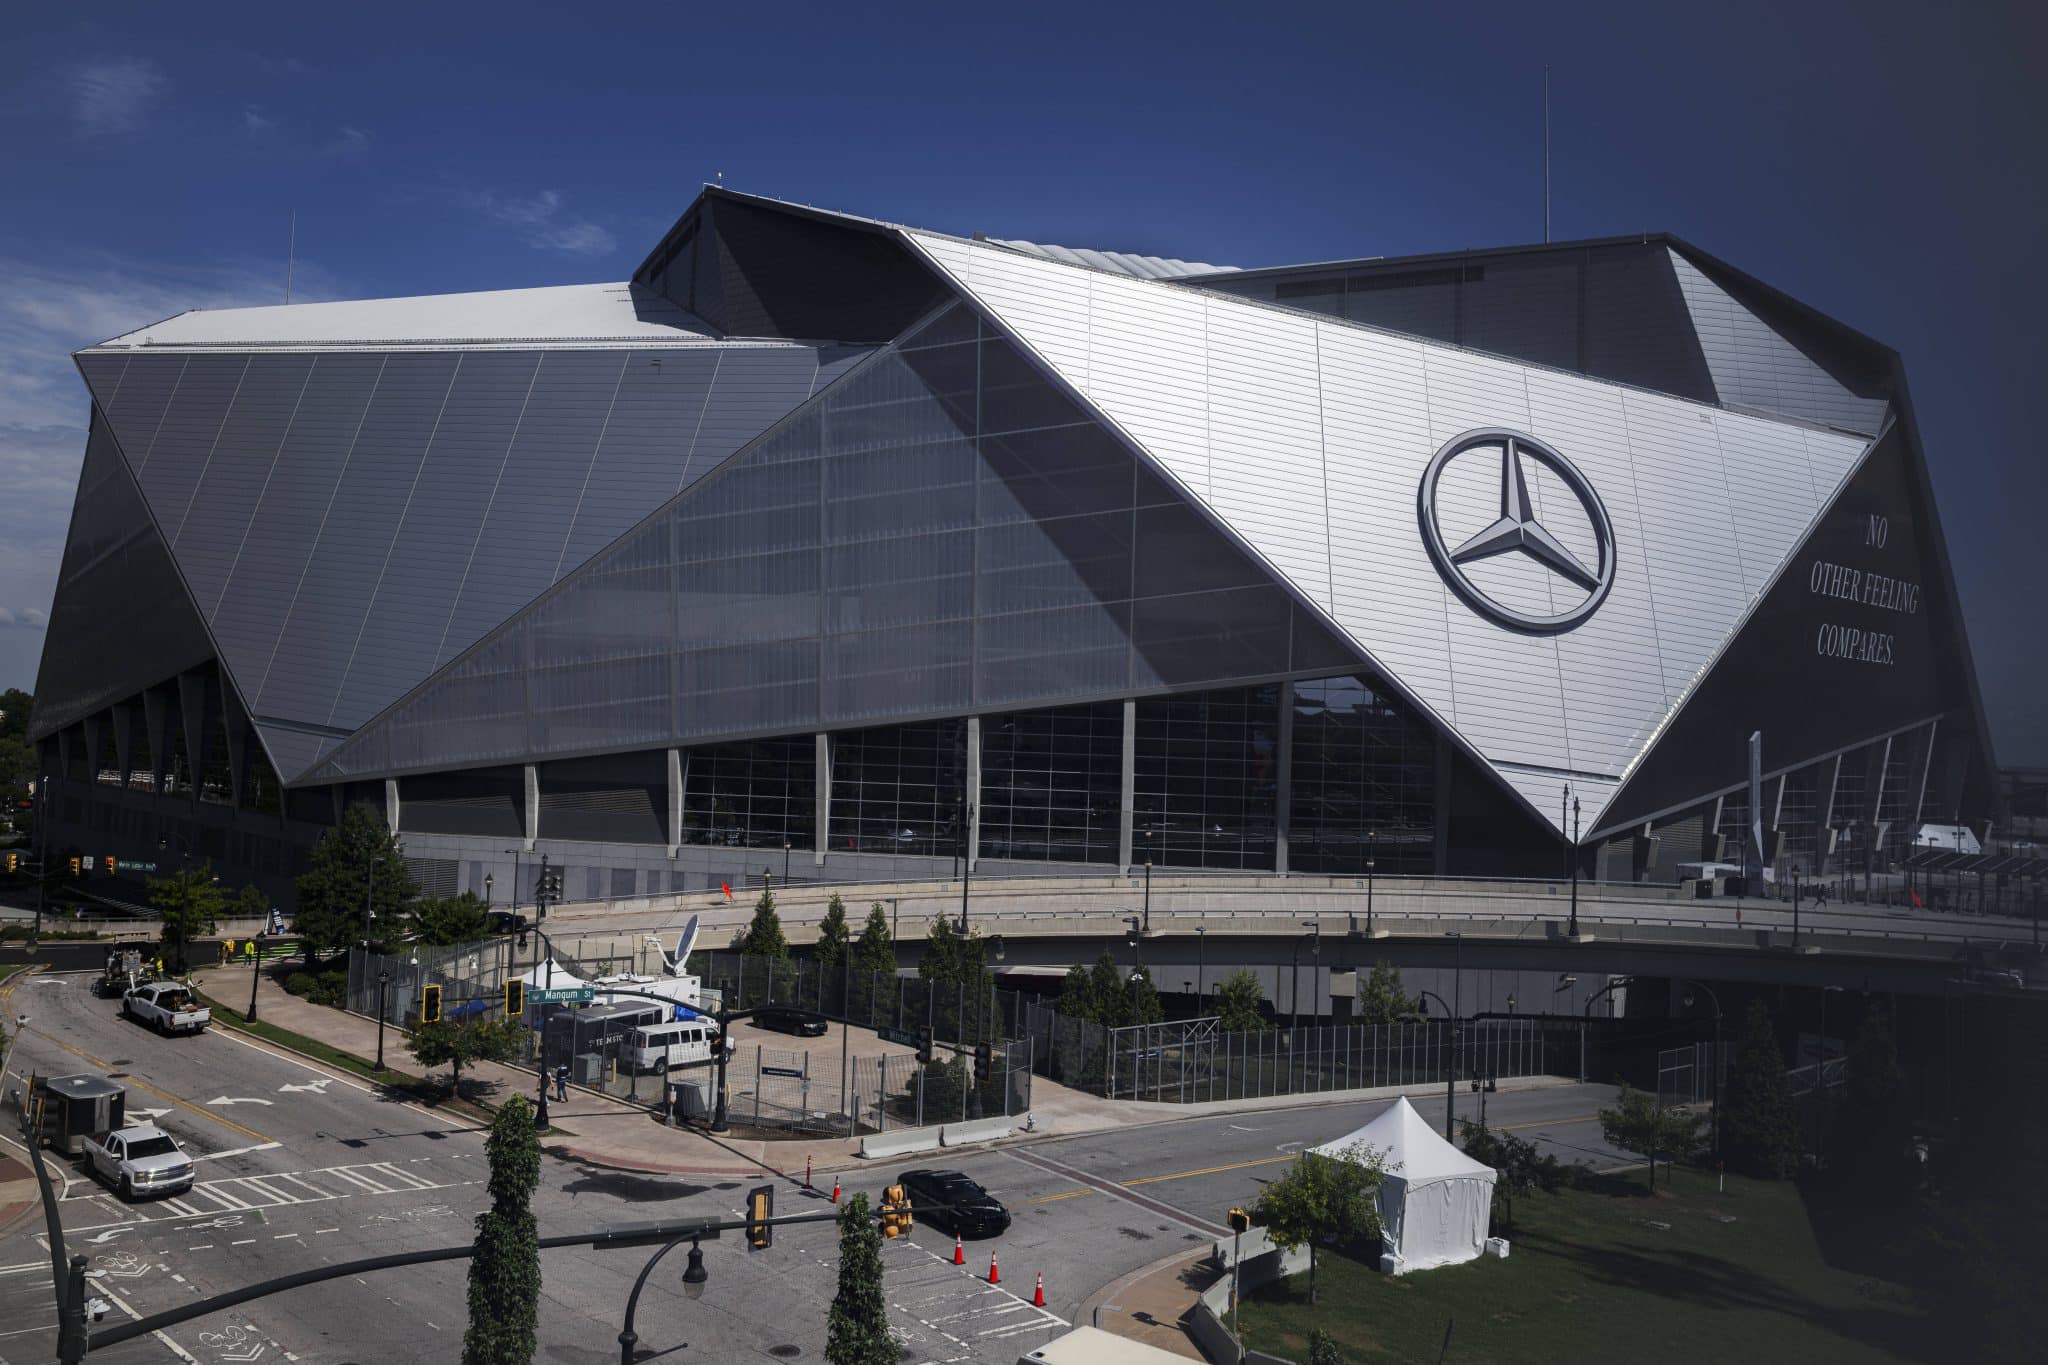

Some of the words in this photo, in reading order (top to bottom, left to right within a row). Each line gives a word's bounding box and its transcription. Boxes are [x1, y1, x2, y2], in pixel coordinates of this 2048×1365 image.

[1866, 514, 1888, 549] NO
[1811, 560, 1862, 602] OTHER
[1862, 573, 1920, 614] FEELING
[1817, 623, 1894, 665] COMPARES.
[545, 990, 578, 1001] Mangum
[584, 990, 591, 998] St
